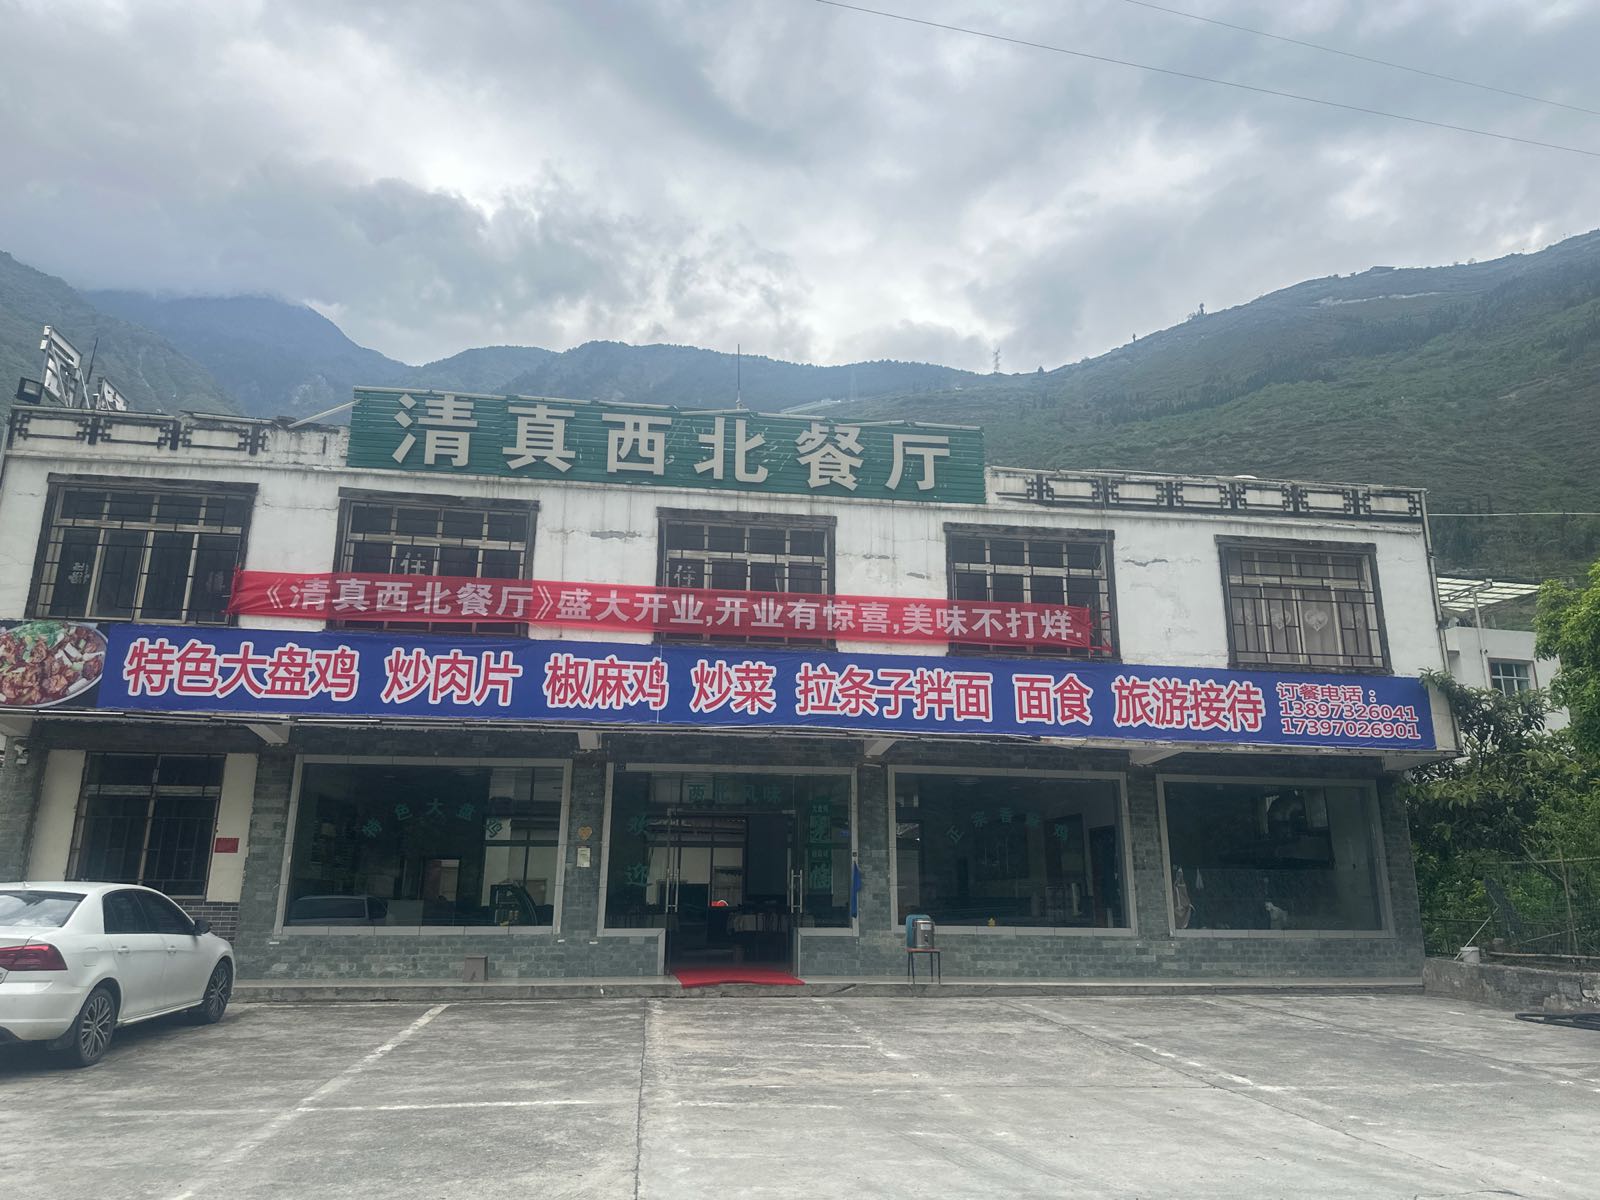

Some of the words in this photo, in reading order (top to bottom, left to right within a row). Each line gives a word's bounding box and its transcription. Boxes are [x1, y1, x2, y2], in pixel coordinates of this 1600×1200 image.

[392, 393, 951, 491] 清真西北餐厅
[124, 638, 359, 701] 特色大盘鸡
[381, 647, 523, 706] 炒肉片
[543, 653, 669, 709] 椒麻鸡
[690, 659, 776, 714] 炒菜
[796, 662, 994, 722] 拉条子拌面
[1012, 674, 1093, 726] 面食
[1111, 676, 1266, 732] 旅游接待
[1280, 701, 1419, 721] 13897326041
[1281, 718, 1421, 739] 17397026901
